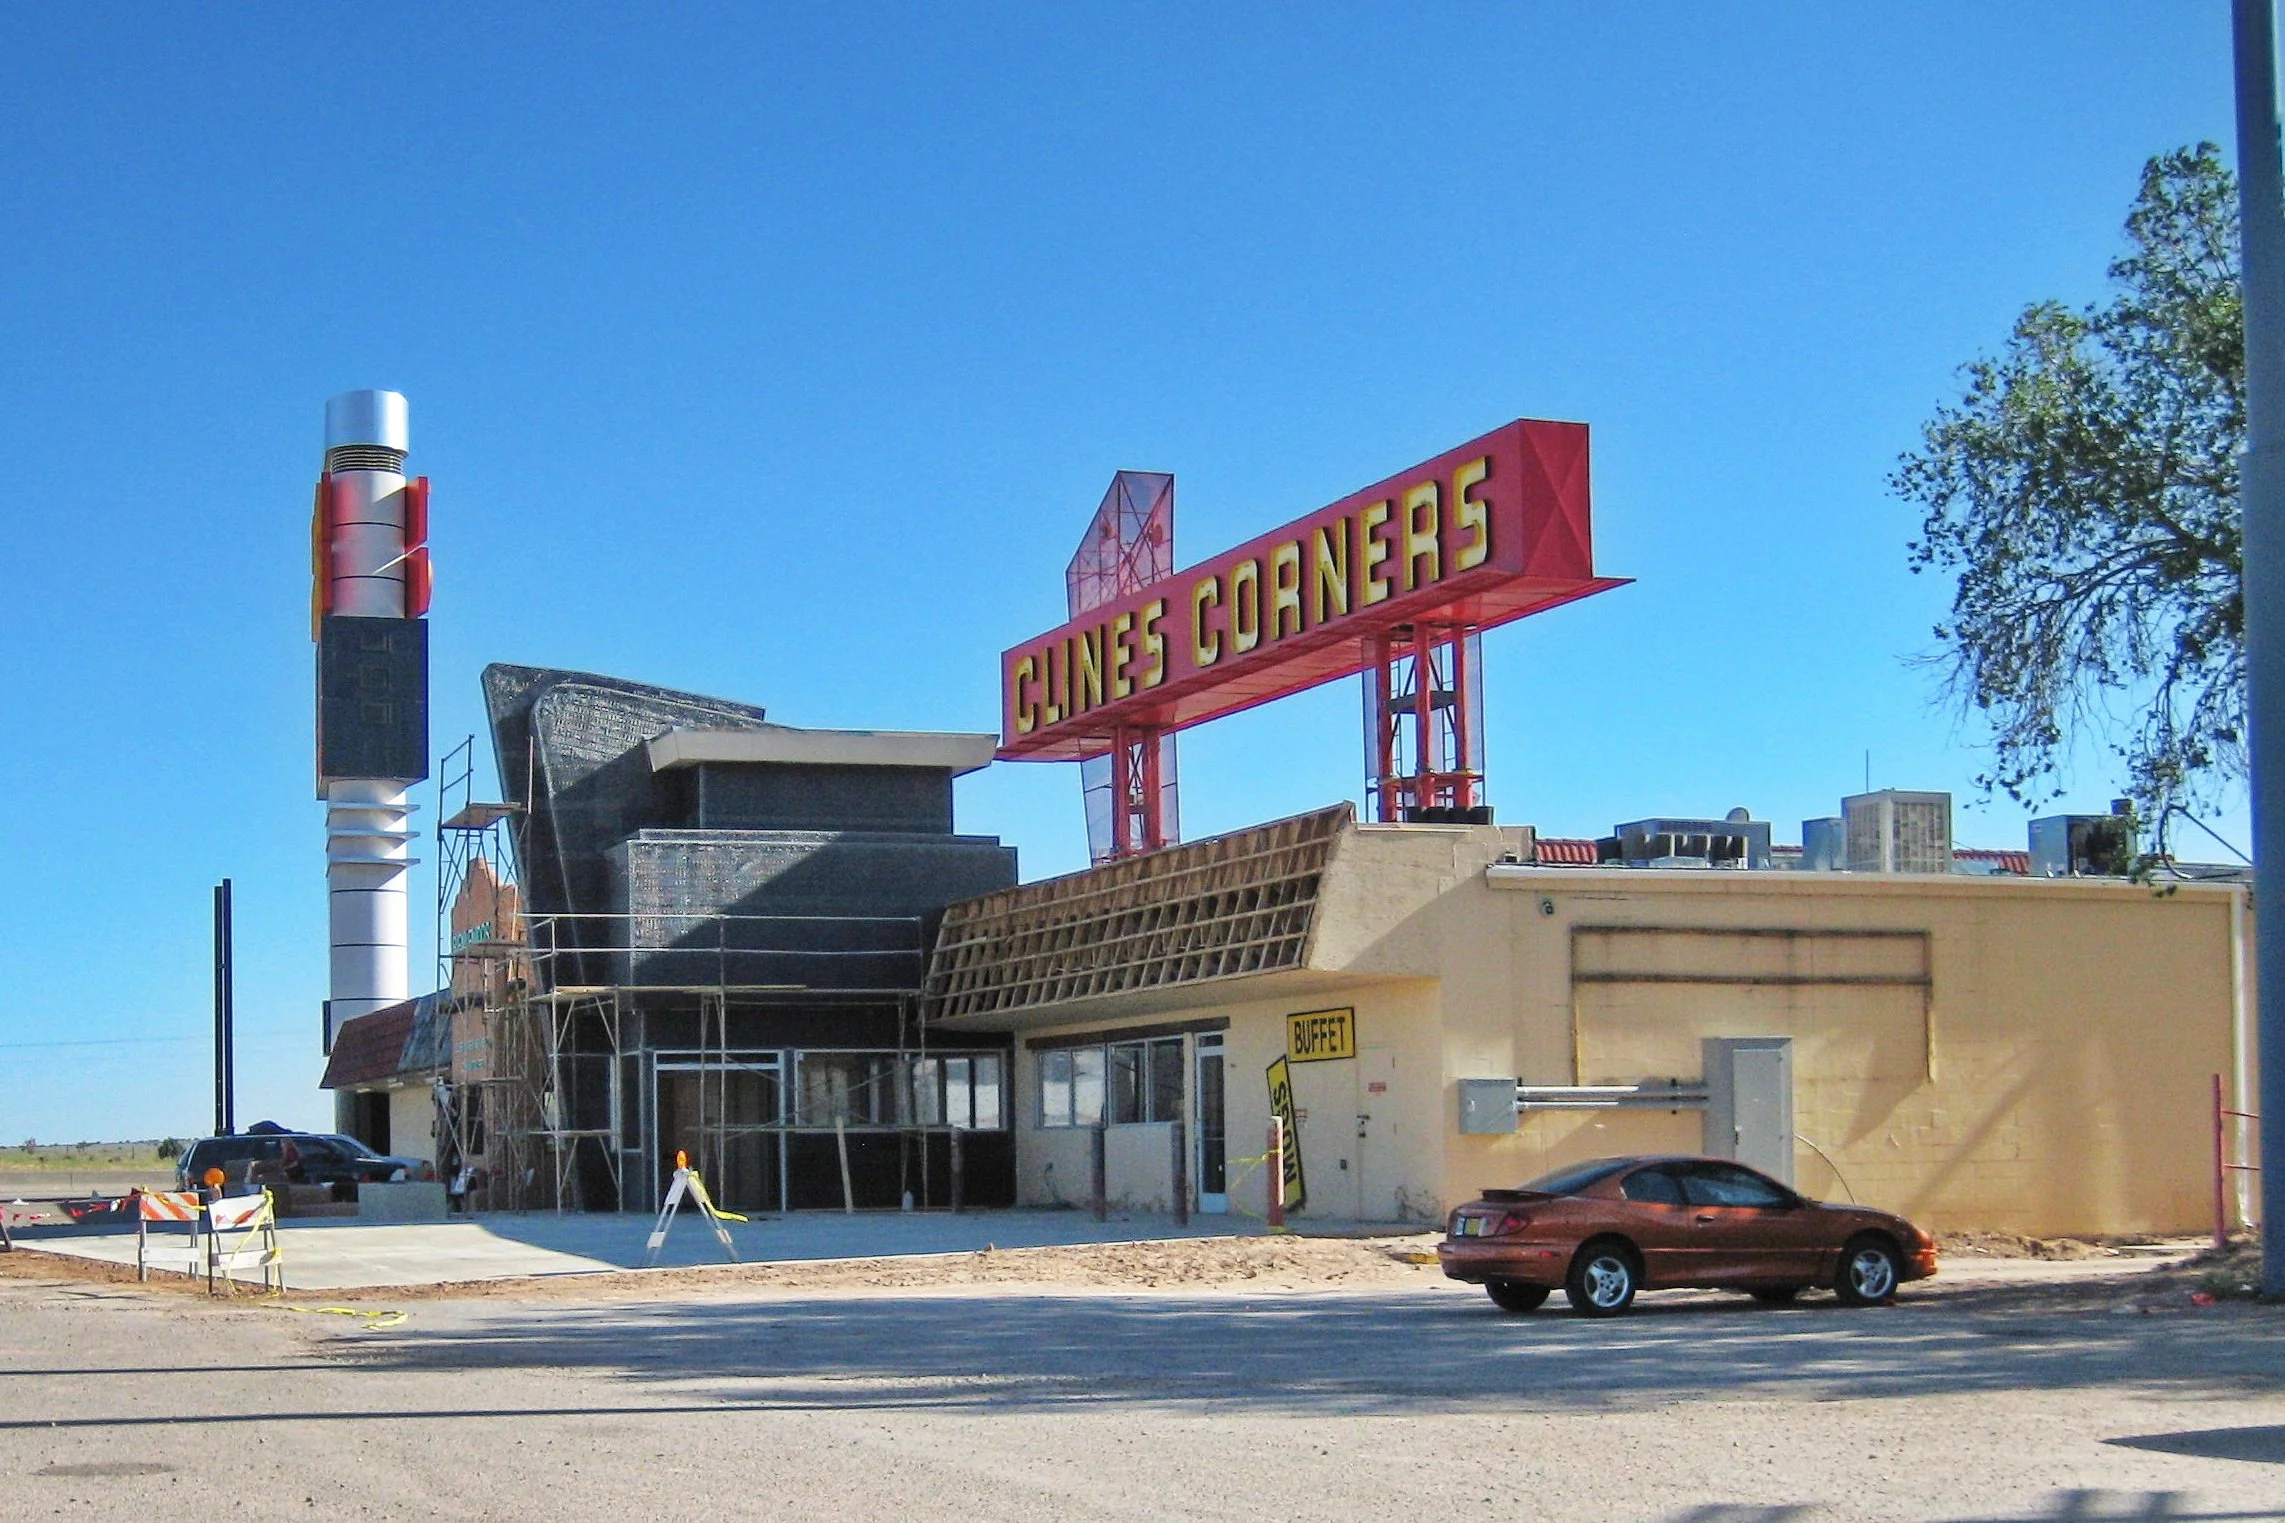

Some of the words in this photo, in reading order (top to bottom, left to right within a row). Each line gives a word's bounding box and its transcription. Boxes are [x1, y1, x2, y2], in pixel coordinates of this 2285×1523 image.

[1013, 598, 1165, 736] CLINES
[1191, 456, 1490, 668] CORNERS
[1294, 1016, 1346, 1054] BUFFET
